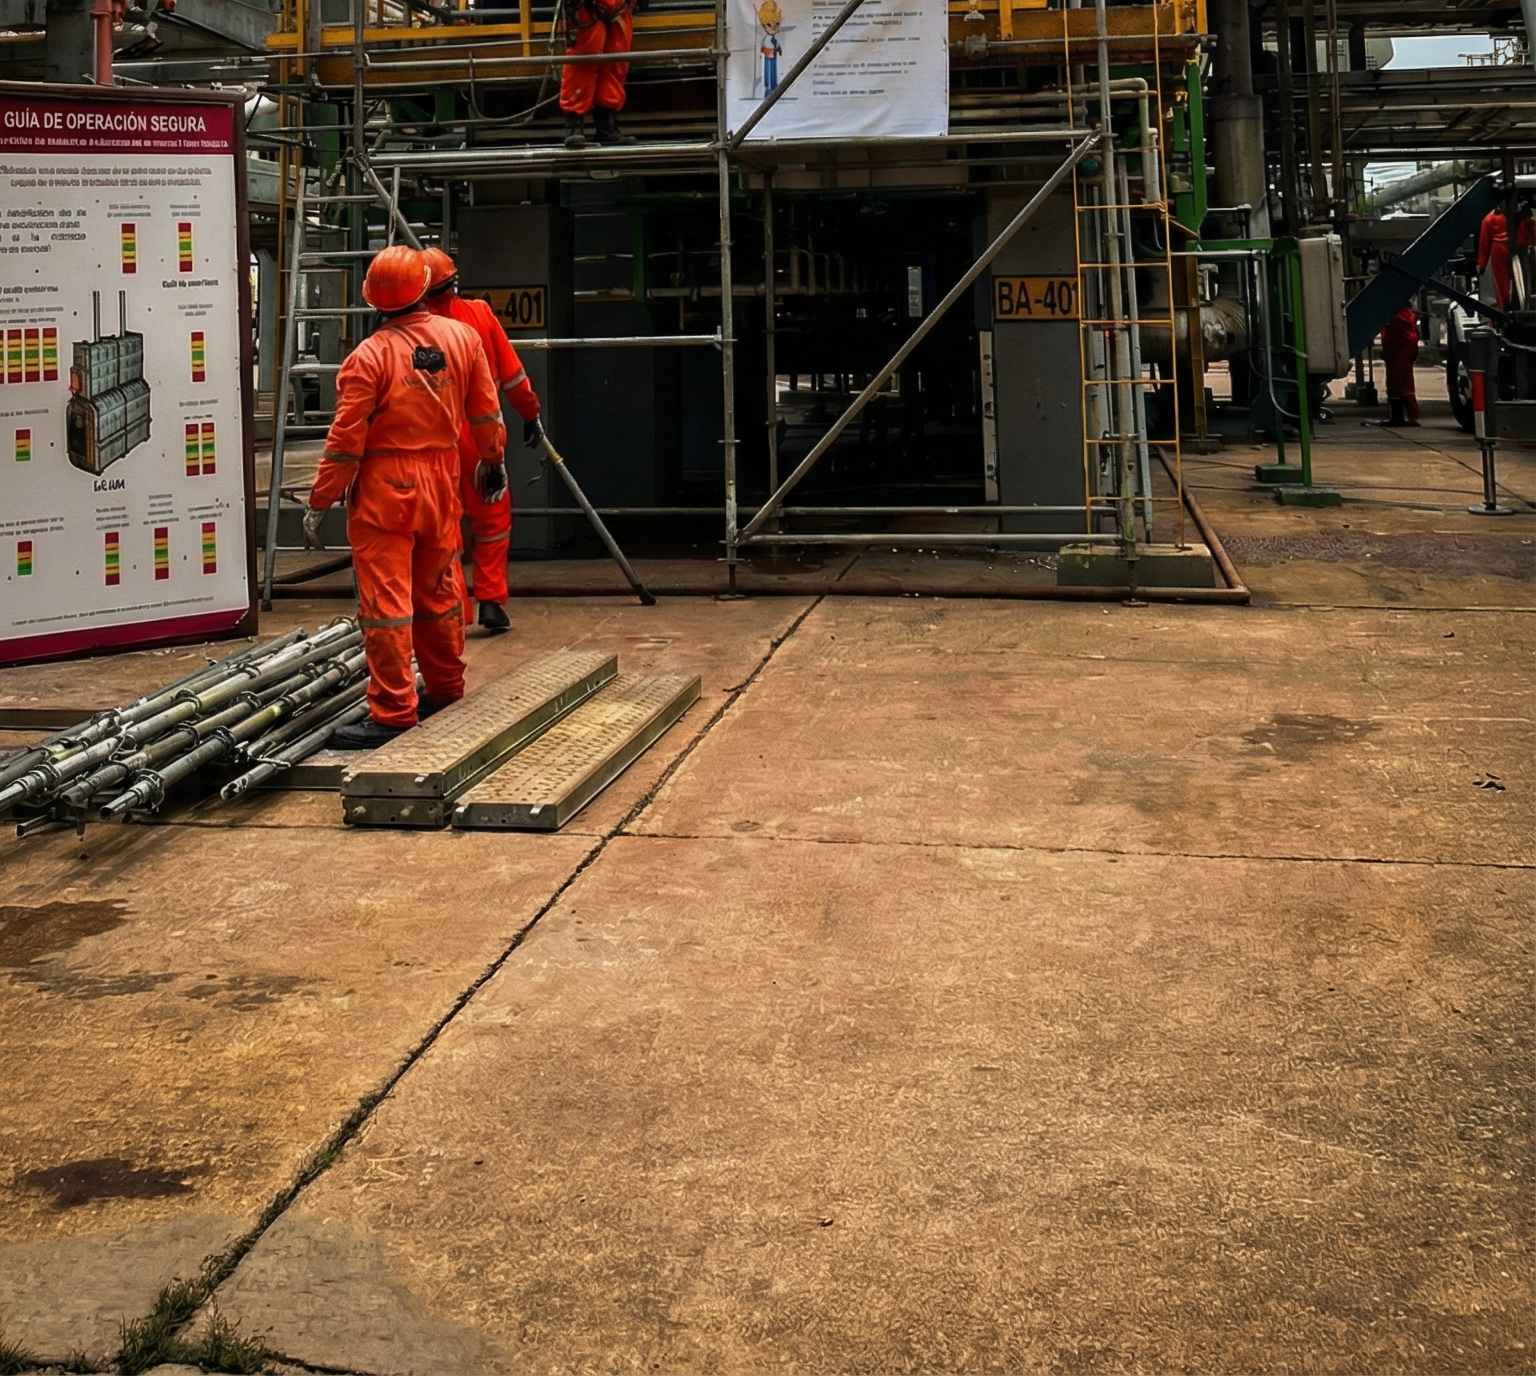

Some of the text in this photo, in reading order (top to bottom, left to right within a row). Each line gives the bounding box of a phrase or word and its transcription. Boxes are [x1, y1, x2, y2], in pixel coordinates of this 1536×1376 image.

[4, 106, 207, 133] GUÍA DE OPERACIÓN SEGURA
